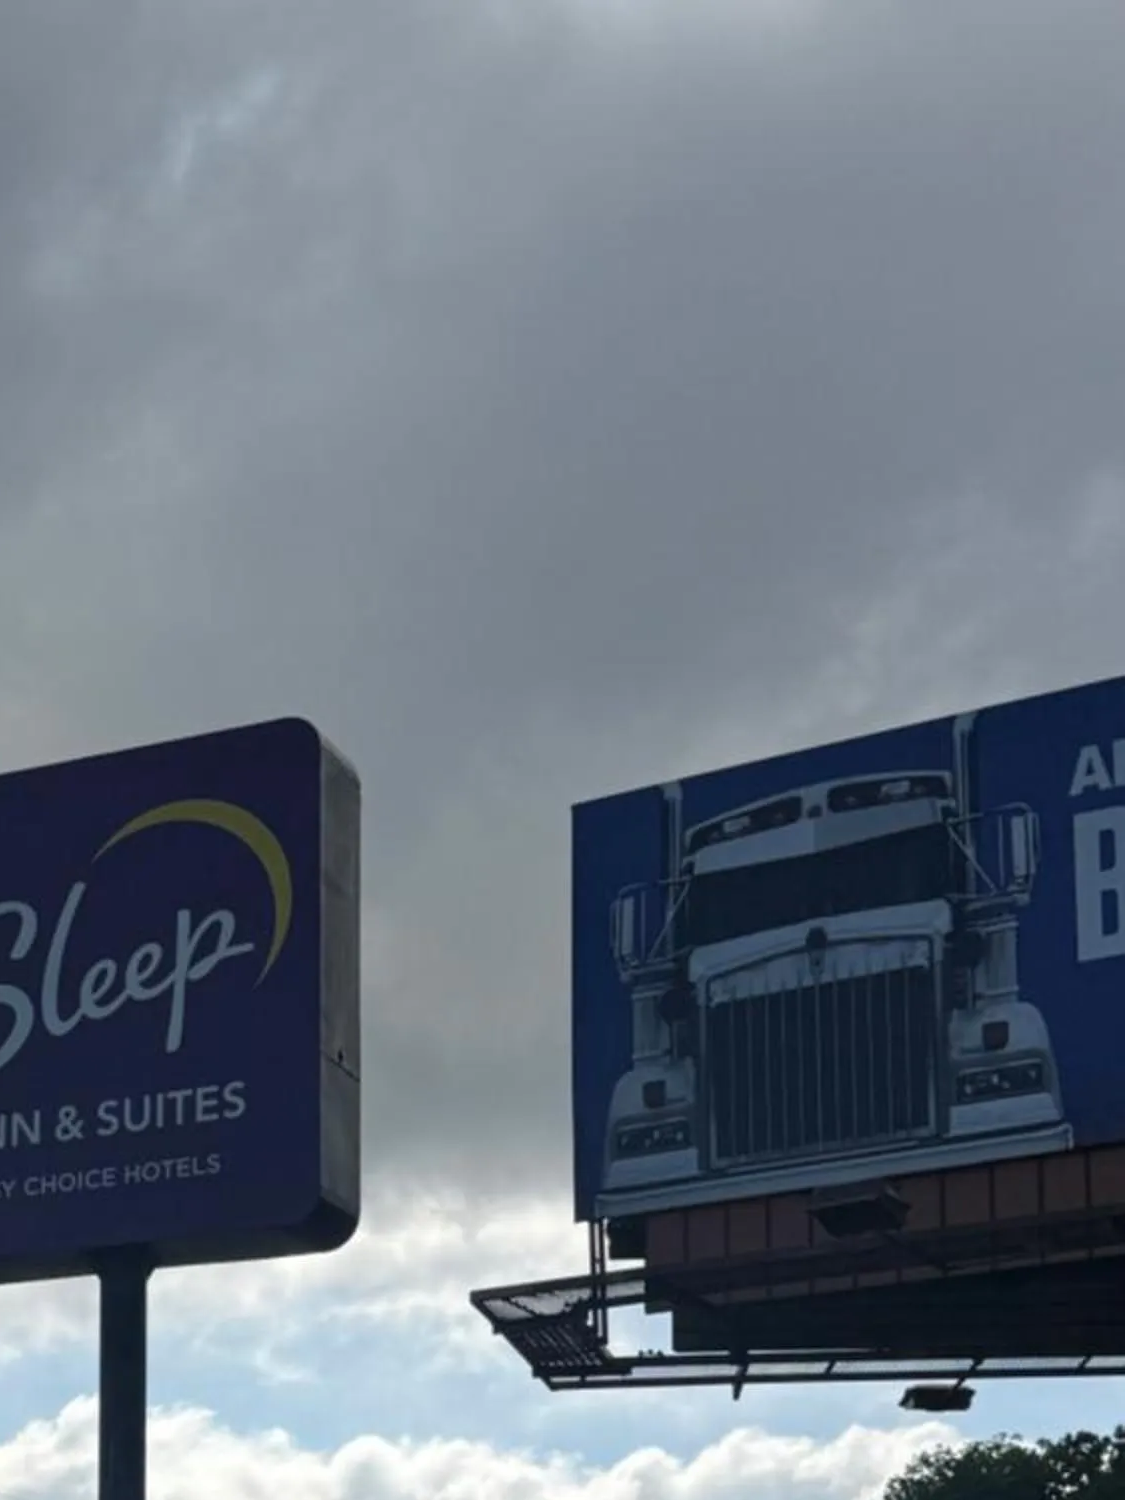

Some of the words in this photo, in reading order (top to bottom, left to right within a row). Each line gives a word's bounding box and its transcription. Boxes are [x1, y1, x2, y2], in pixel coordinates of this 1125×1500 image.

[54, 1104, 85, 1142] &
[95, 1080, 248, 1137] SUITES
[23, 1166, 117, 1197] CHOICE
[123, 1153, 222, 1185] HOTELS
